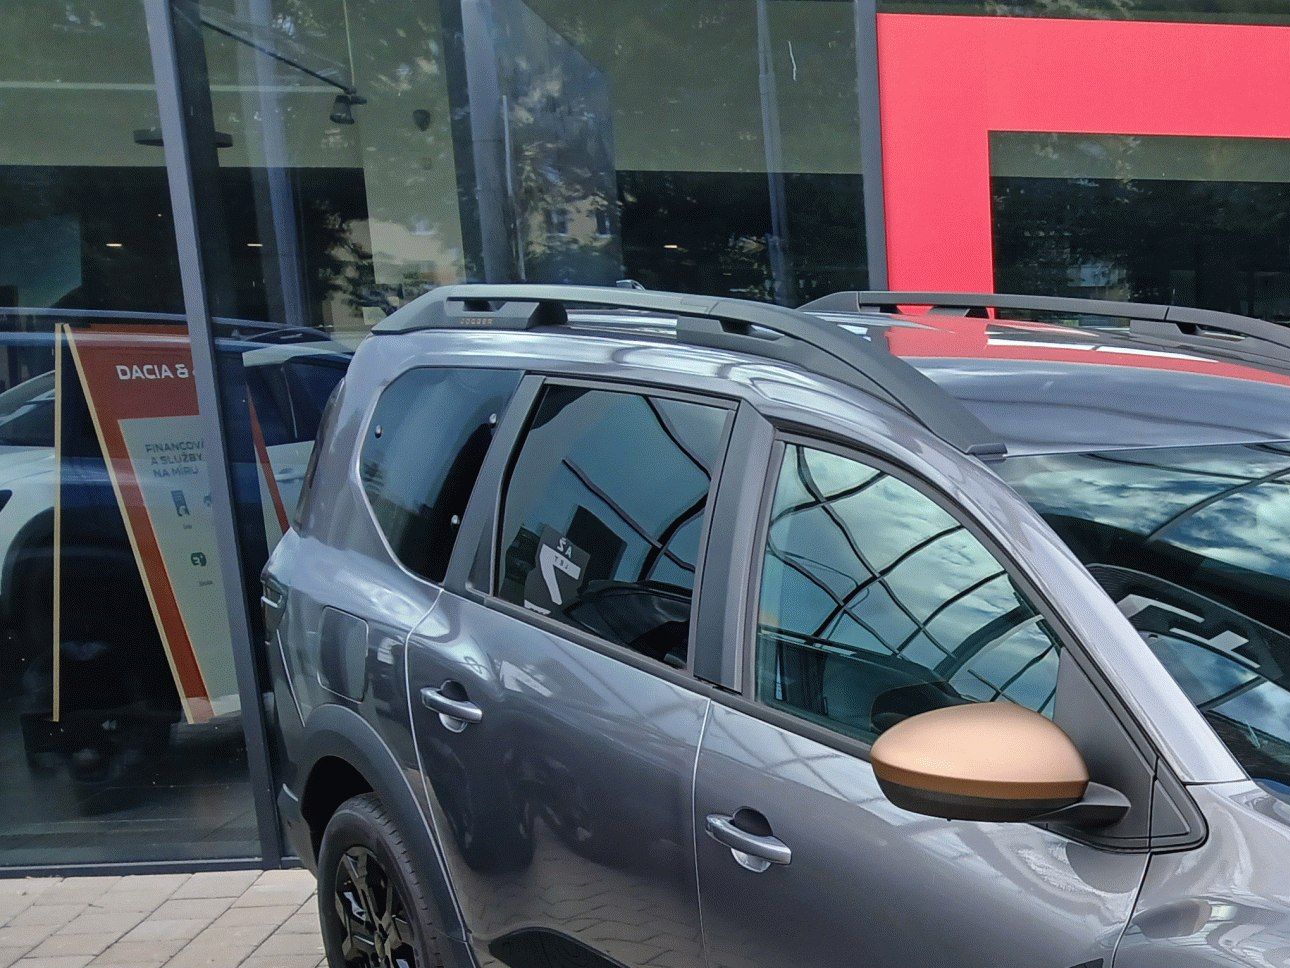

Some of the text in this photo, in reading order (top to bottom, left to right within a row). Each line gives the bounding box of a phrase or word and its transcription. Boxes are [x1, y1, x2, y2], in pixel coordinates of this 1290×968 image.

[116, 364, 174, 380] DACIA
[175, 363, 189, 378] &
[151, 456, 158, 465] A
[153, 469, 170, 478] NA
